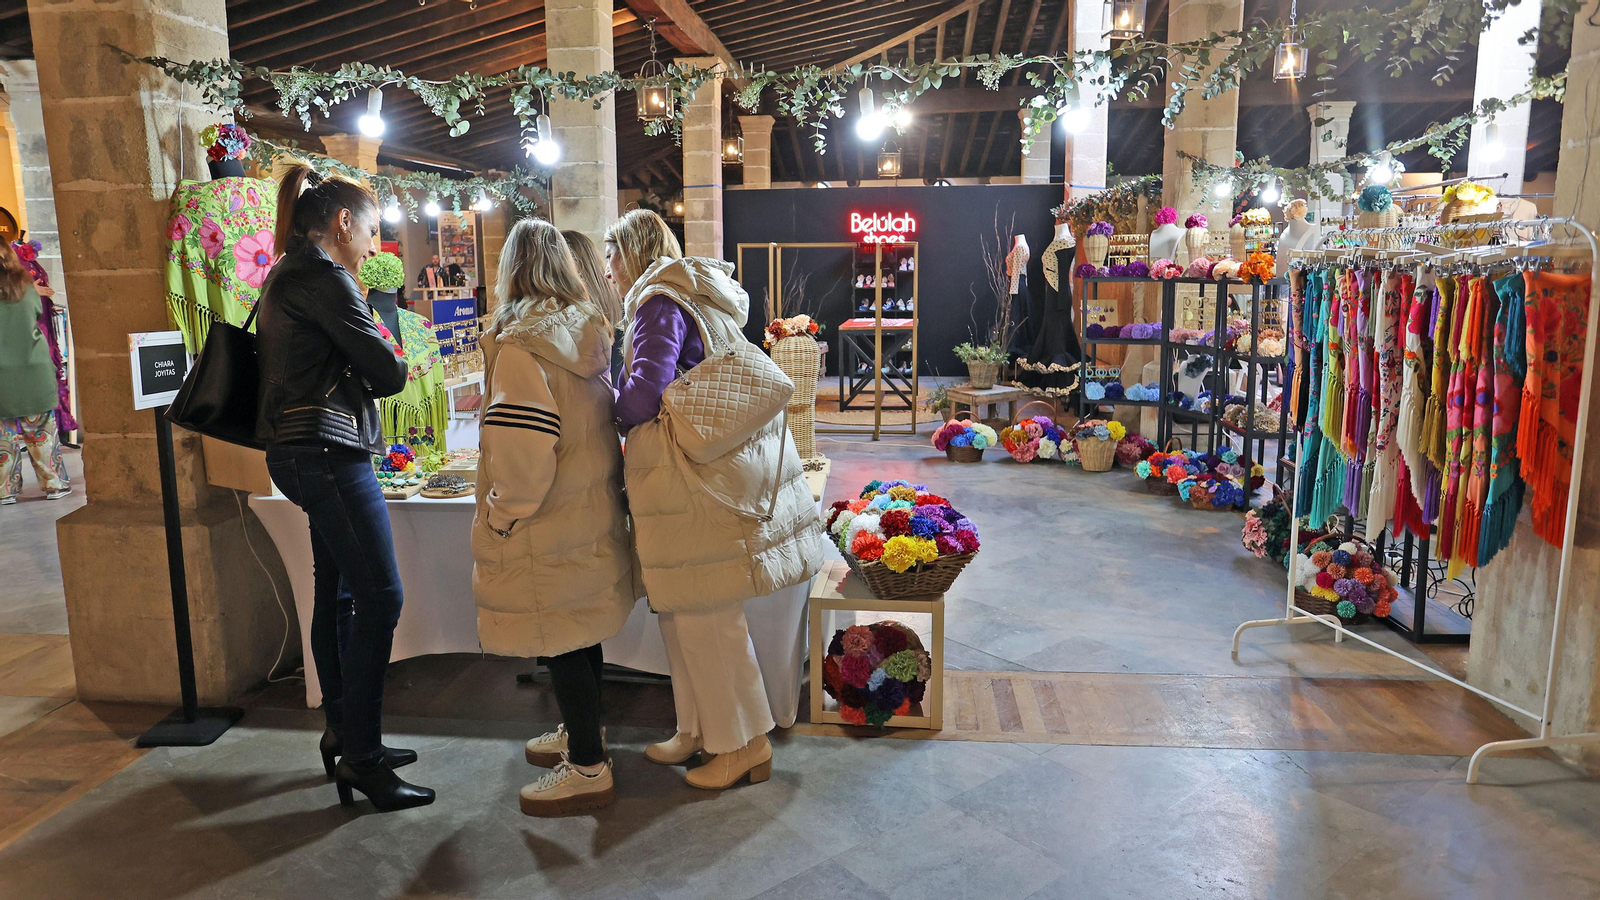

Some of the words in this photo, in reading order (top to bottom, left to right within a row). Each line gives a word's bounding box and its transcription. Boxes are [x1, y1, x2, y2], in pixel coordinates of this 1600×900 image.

[851, 212, 916, 233] Belúlah
[863, 231, 906, 244] shoes
[154, 360, 174, 369] CHIARA
[154, 368, 176, 378] JOYITAS
